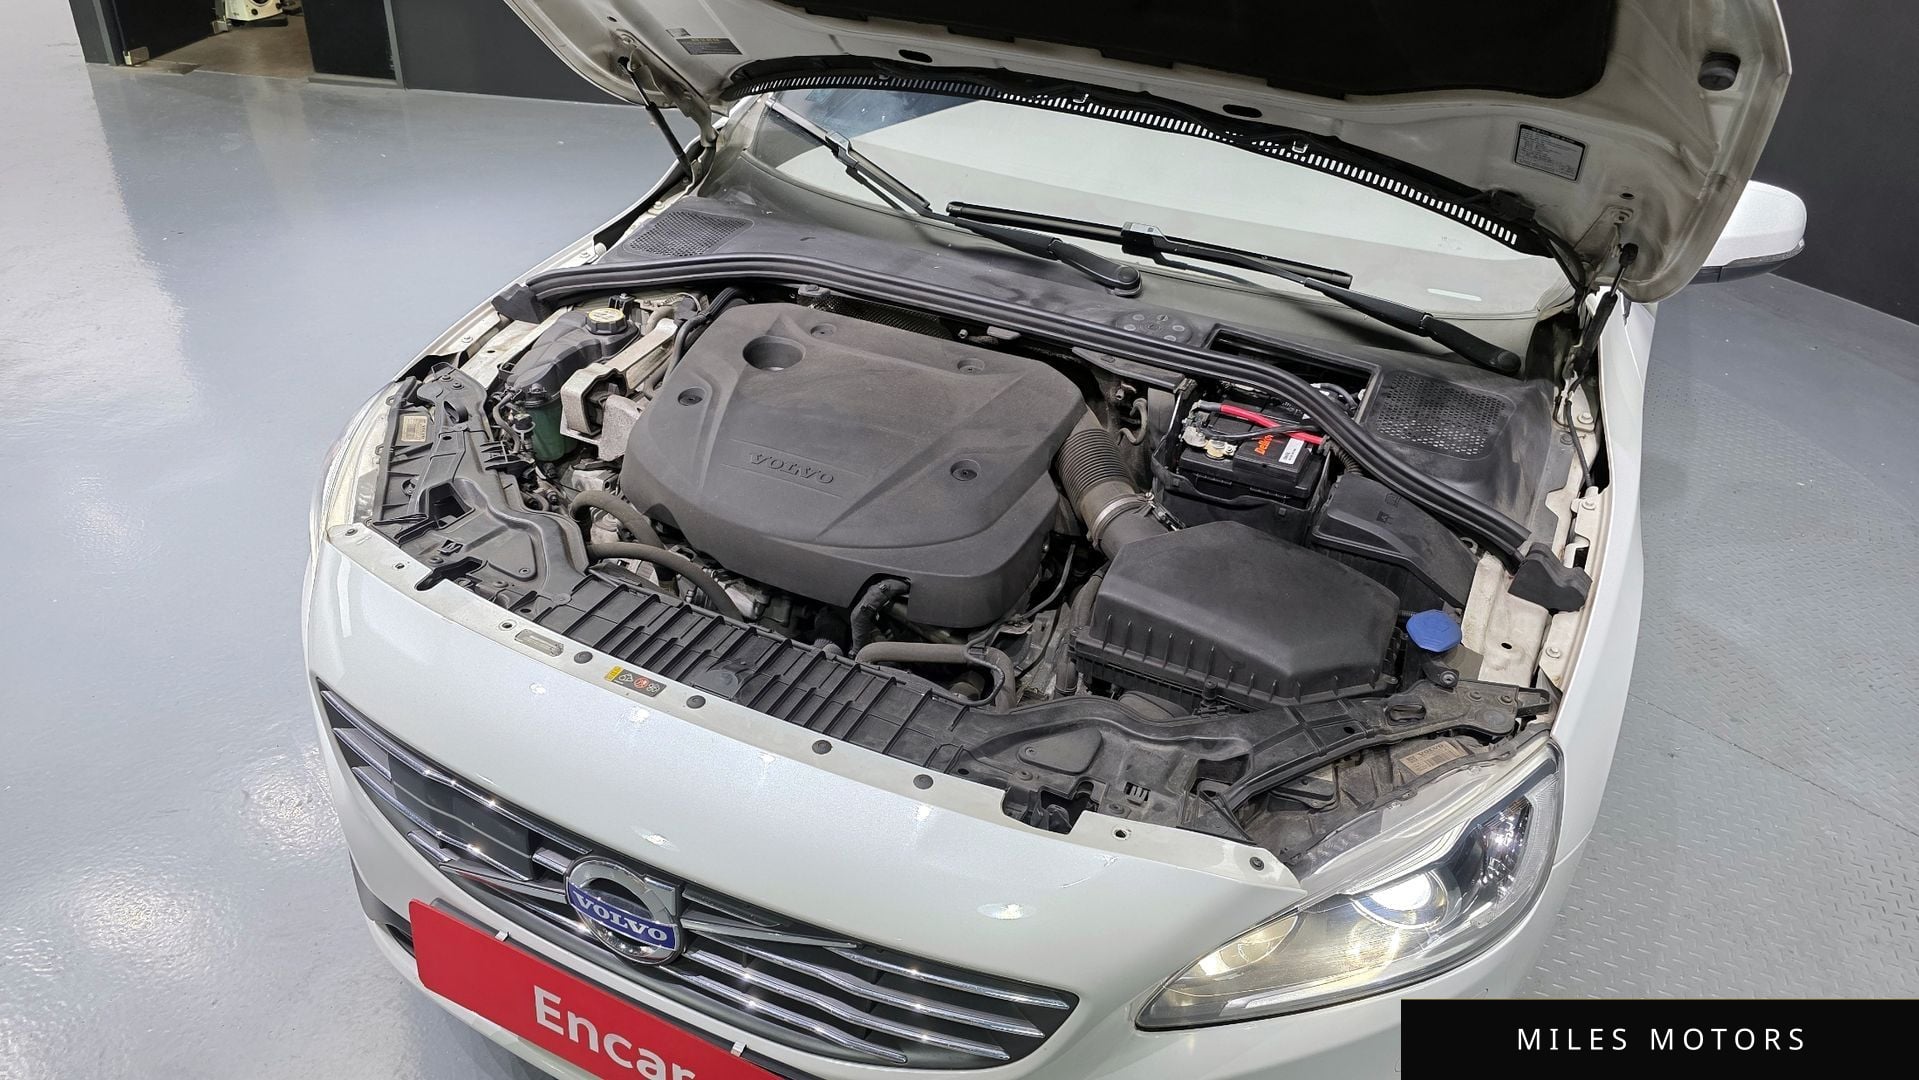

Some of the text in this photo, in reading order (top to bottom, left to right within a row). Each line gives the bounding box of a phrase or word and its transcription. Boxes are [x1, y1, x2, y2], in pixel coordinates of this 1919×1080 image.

[750, 453, 834, 484] VOLVO
[572, 890, 668, 941] VOLVO
[533, 984, 696, 1080] Encar
